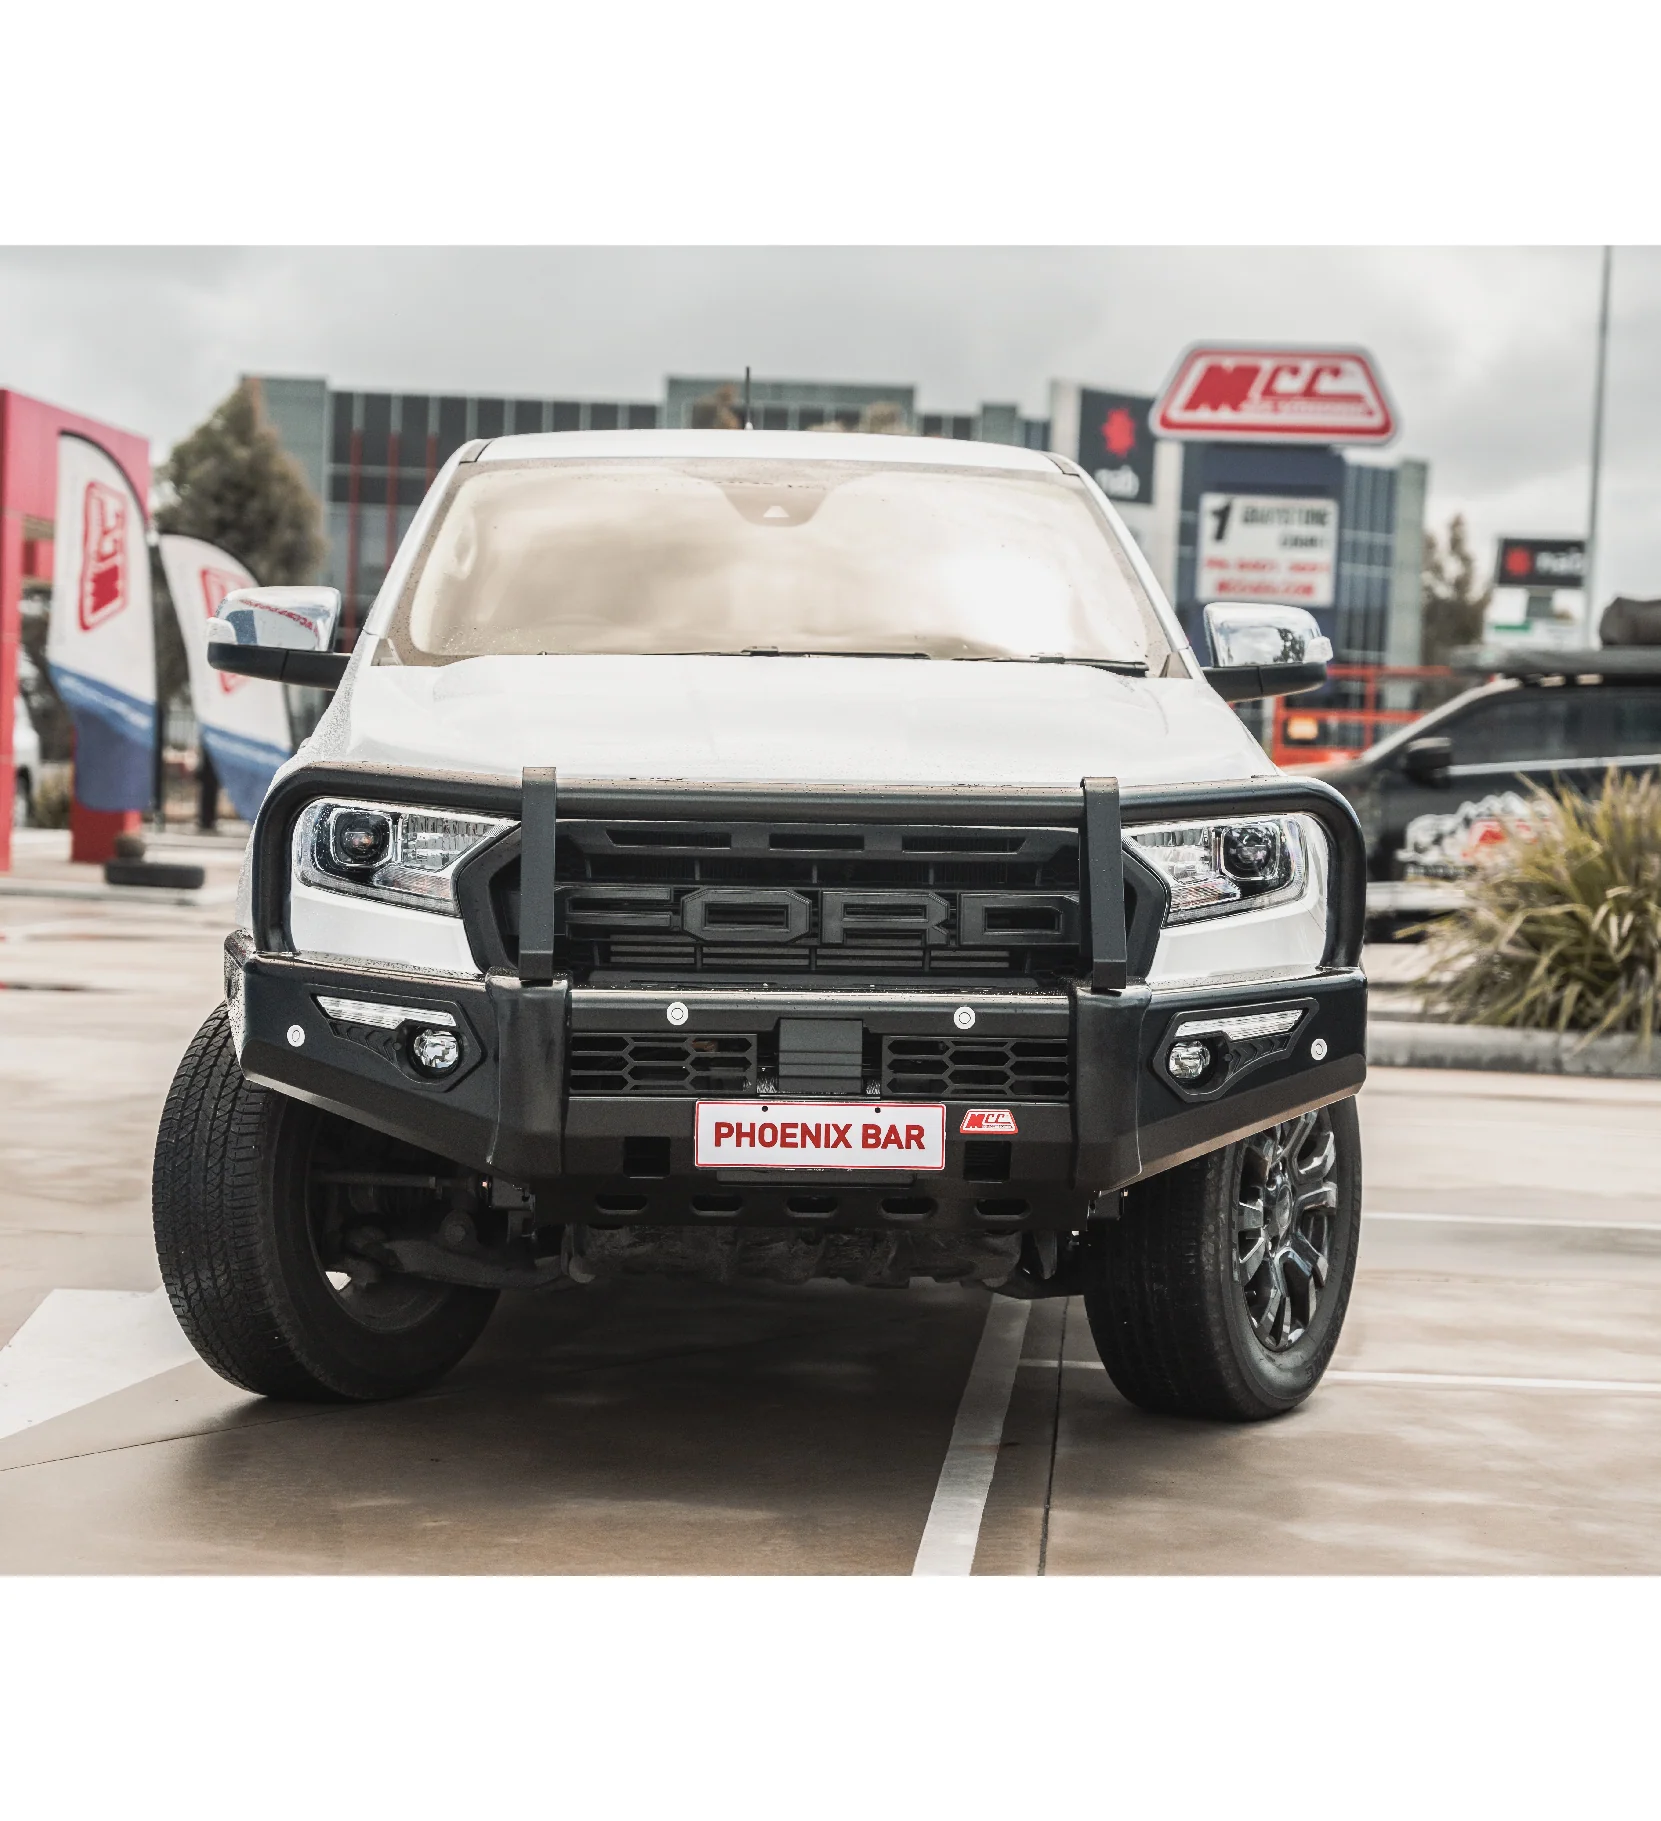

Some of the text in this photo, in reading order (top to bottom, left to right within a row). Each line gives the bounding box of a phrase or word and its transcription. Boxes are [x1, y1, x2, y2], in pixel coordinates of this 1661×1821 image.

[554, 885, 1080, 946] FORD
[965, 1113, 1012, 1129] MCC
[714, 1122, 926, 1150] PHOENIX BAR
